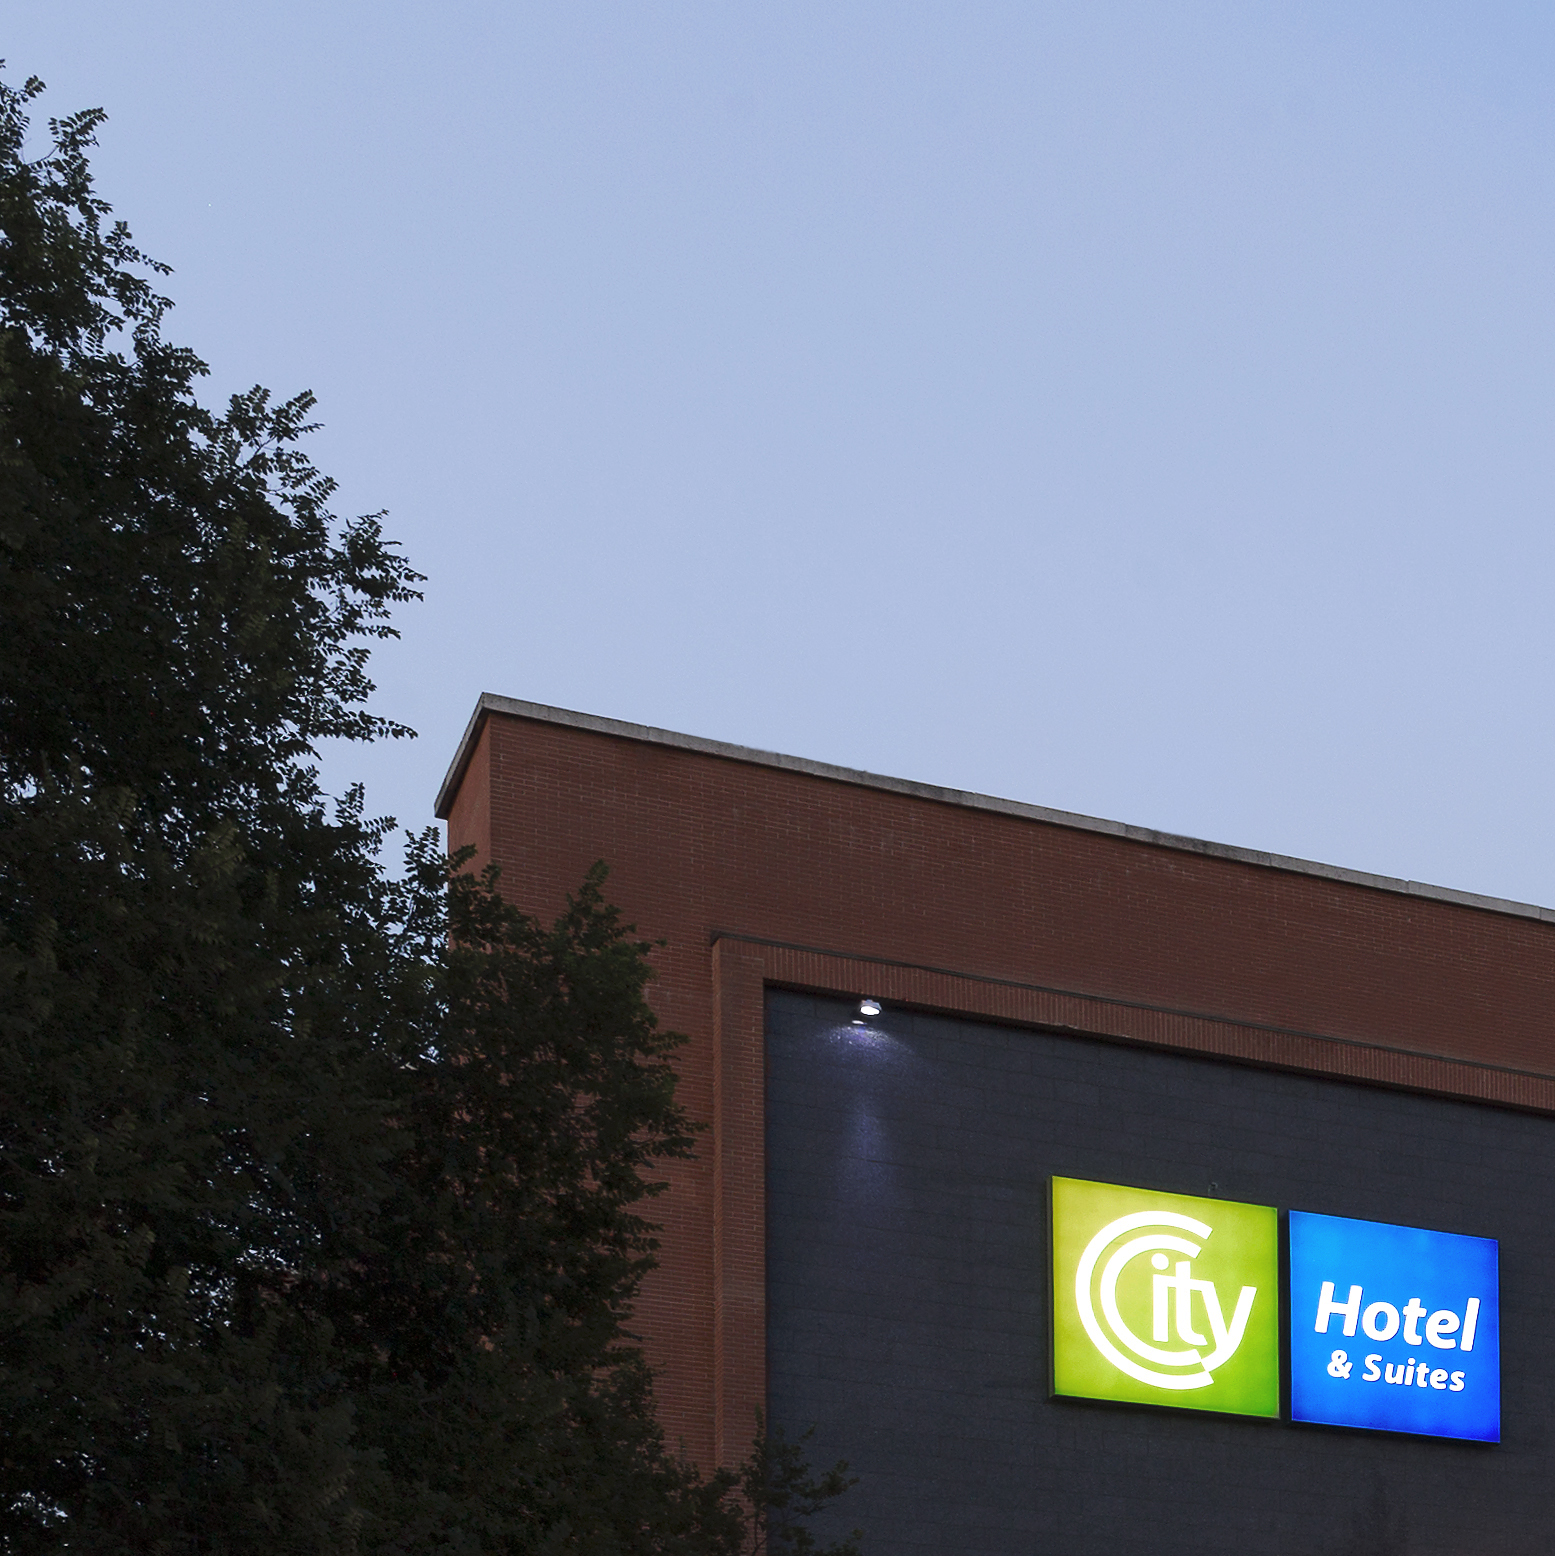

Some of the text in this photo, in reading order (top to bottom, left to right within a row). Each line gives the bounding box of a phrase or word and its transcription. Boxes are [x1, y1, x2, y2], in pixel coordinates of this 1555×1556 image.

[1074, 1210, 1258, 1390] City
[1314, 1281, 1481, 1352] Hotel
[1326, 1349, 1466, 1392] & Suites
